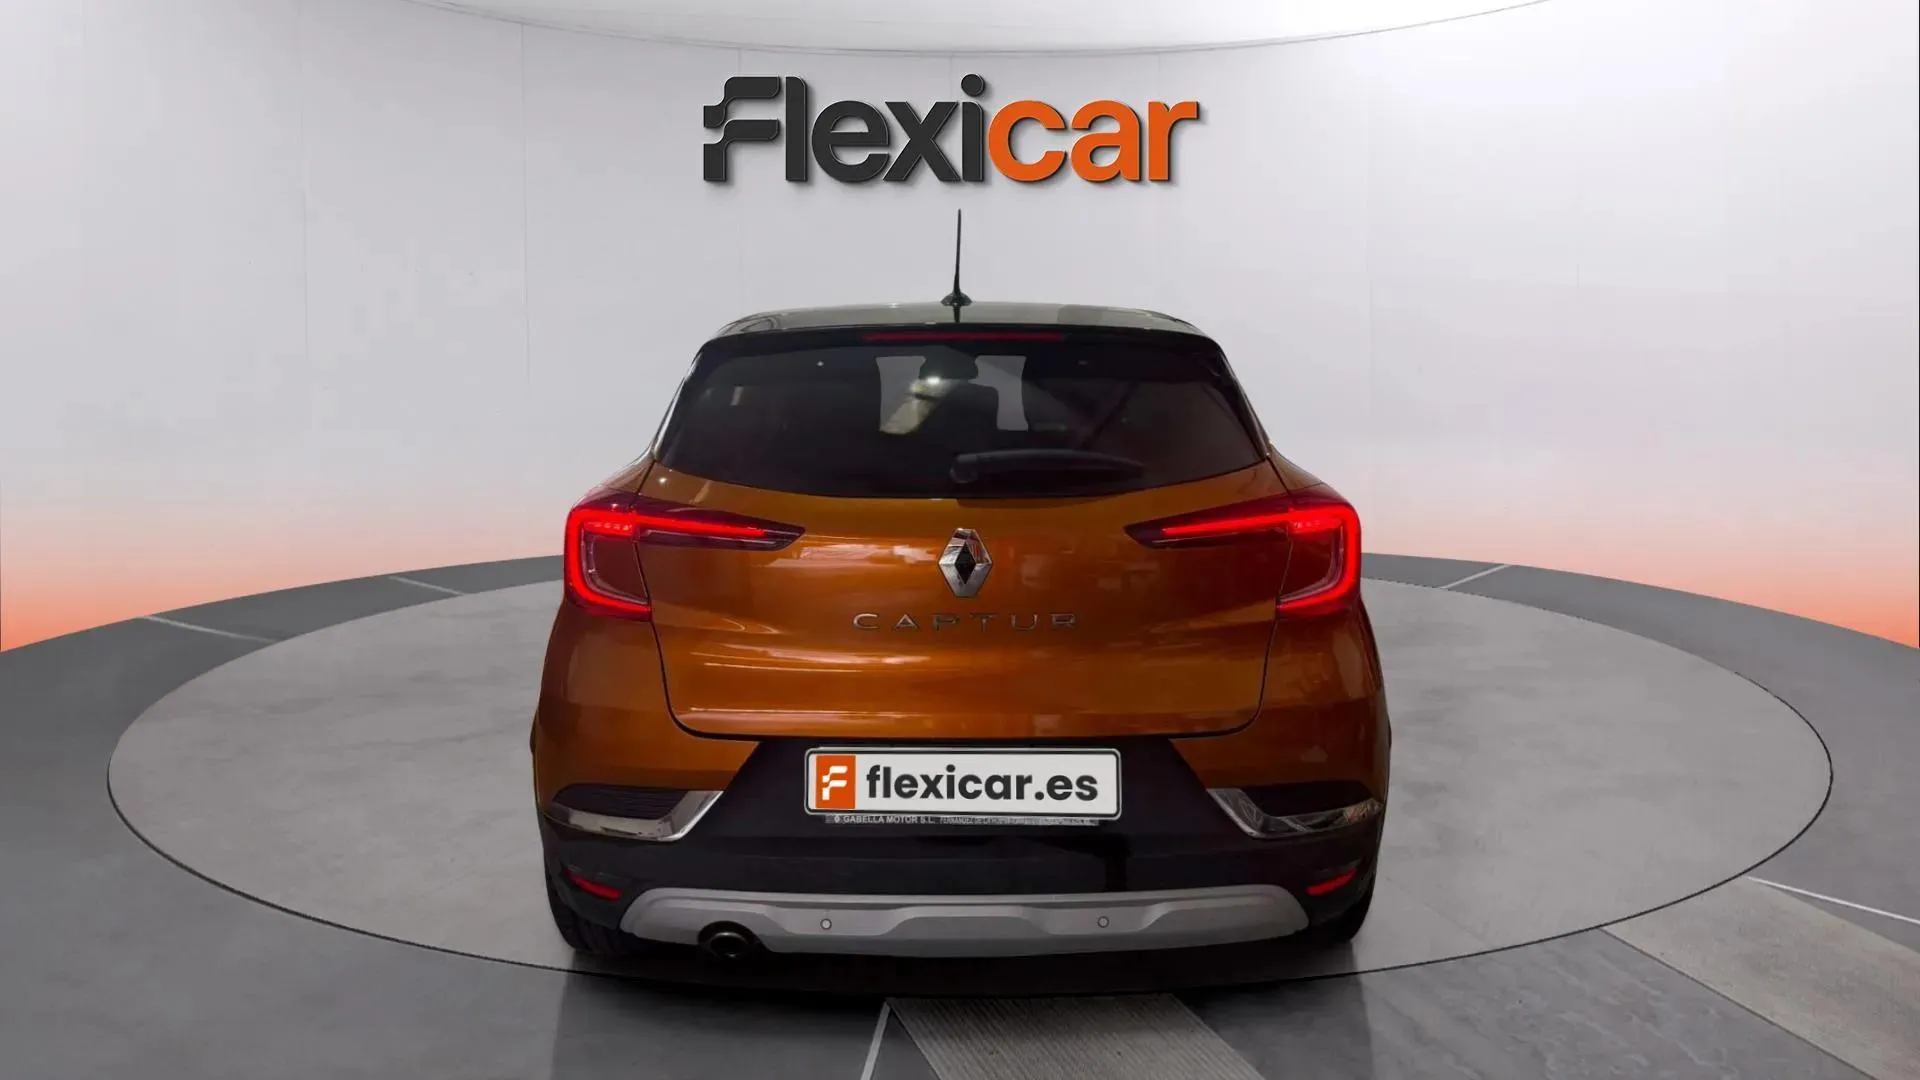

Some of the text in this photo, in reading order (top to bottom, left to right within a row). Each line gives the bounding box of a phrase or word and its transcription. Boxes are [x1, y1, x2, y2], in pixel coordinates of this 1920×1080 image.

[703, 73, 1200, 183] Flexicar
[852, 613, 1078, 632] CAPTUR
[866, 764, 1099, 801] flexicar.es
[843, 815, 885, 824] GABELLA
[886, 815, 918, 824] MOTOR
